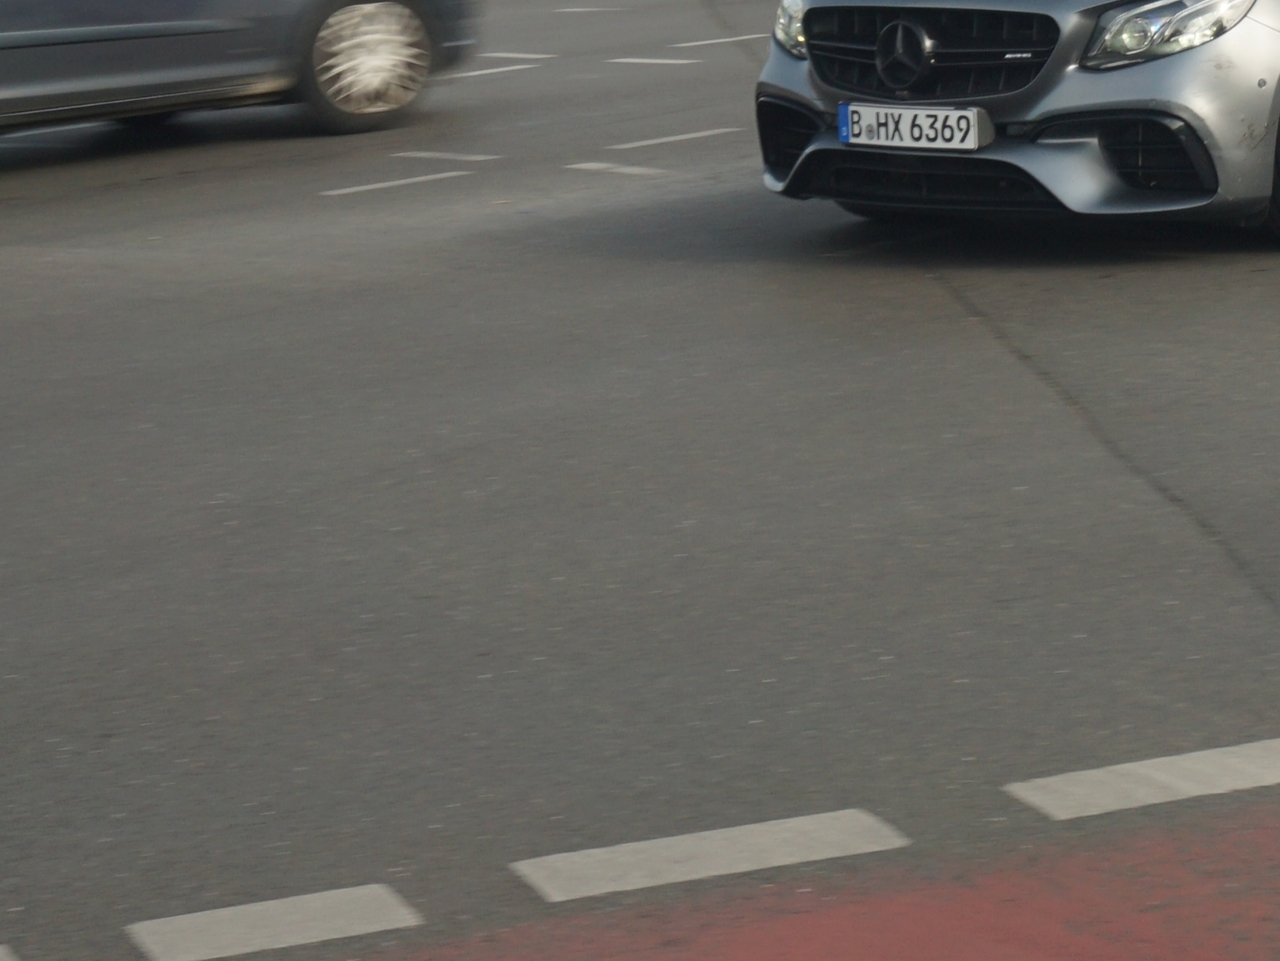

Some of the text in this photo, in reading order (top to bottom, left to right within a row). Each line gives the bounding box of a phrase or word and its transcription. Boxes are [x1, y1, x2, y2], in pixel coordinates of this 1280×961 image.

[851, 110, 970, 143] B HX 6369
